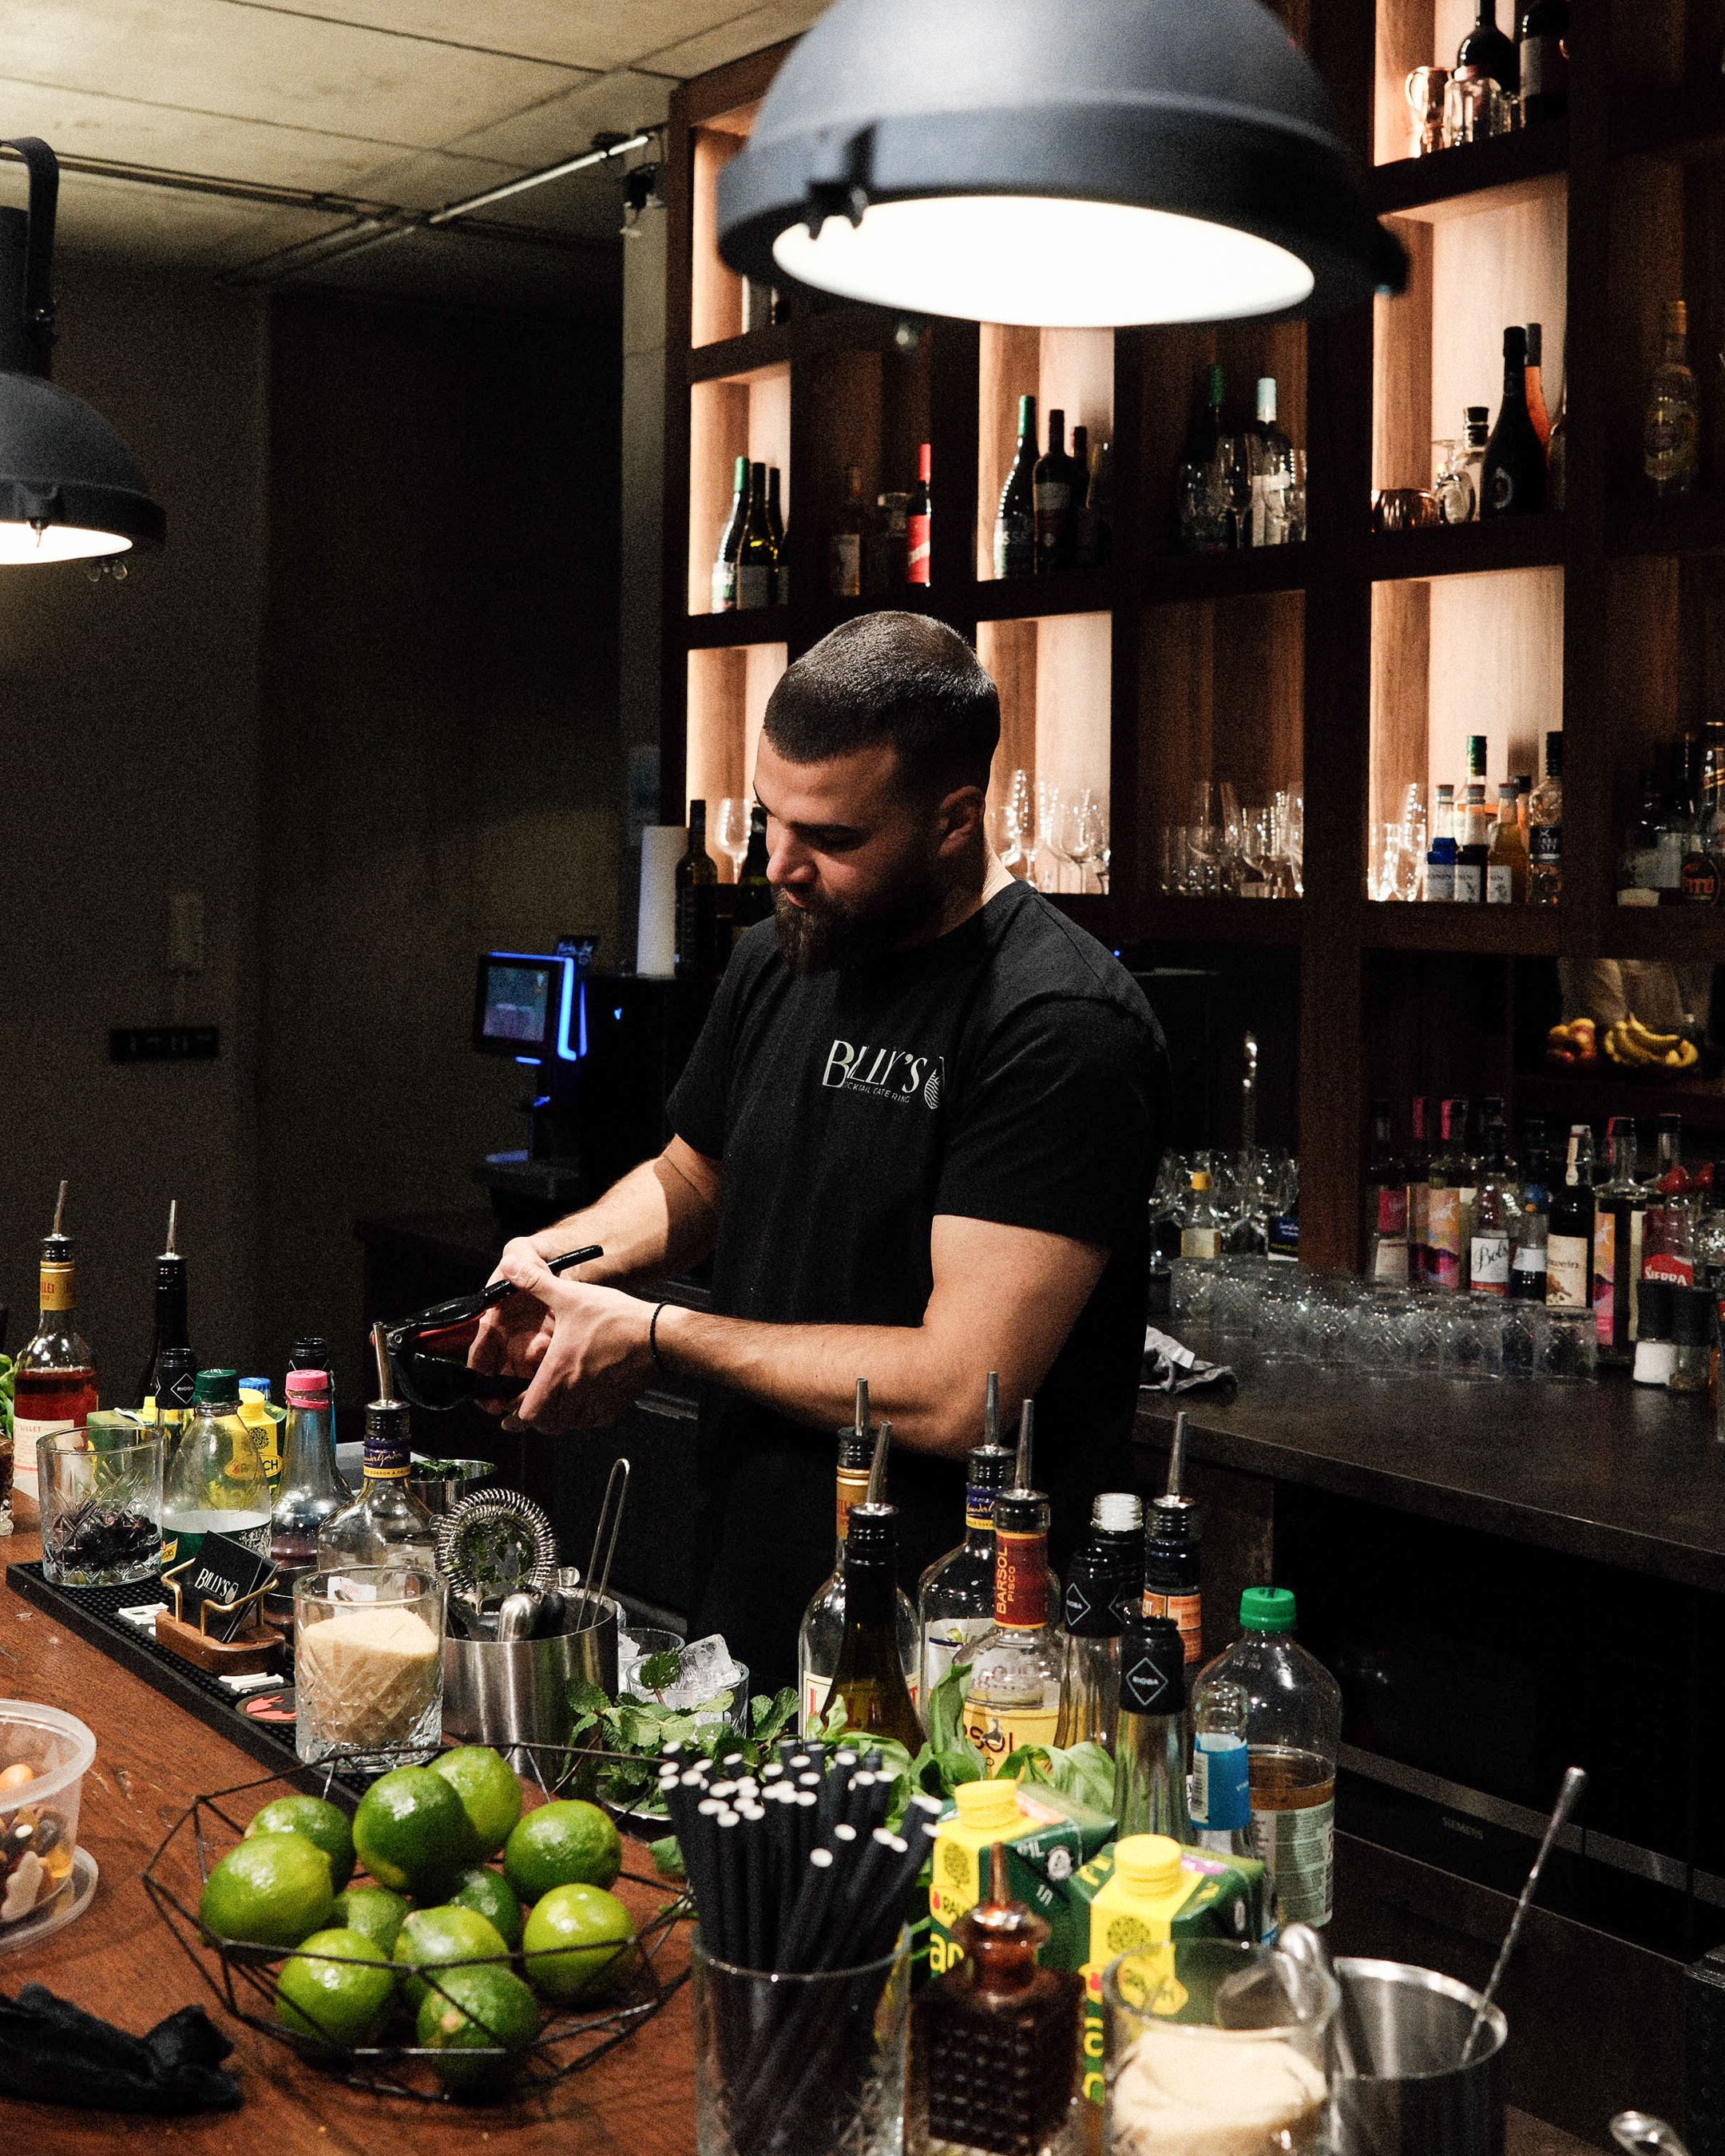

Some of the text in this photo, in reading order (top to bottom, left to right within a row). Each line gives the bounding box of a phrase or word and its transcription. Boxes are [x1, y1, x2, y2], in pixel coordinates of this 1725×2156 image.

[194, 1567, 231, 1597] BILLY'S
[997, 1545, 1009, 1615] BARSOL
[1007, 1566, 1017, 1602] PISCO
